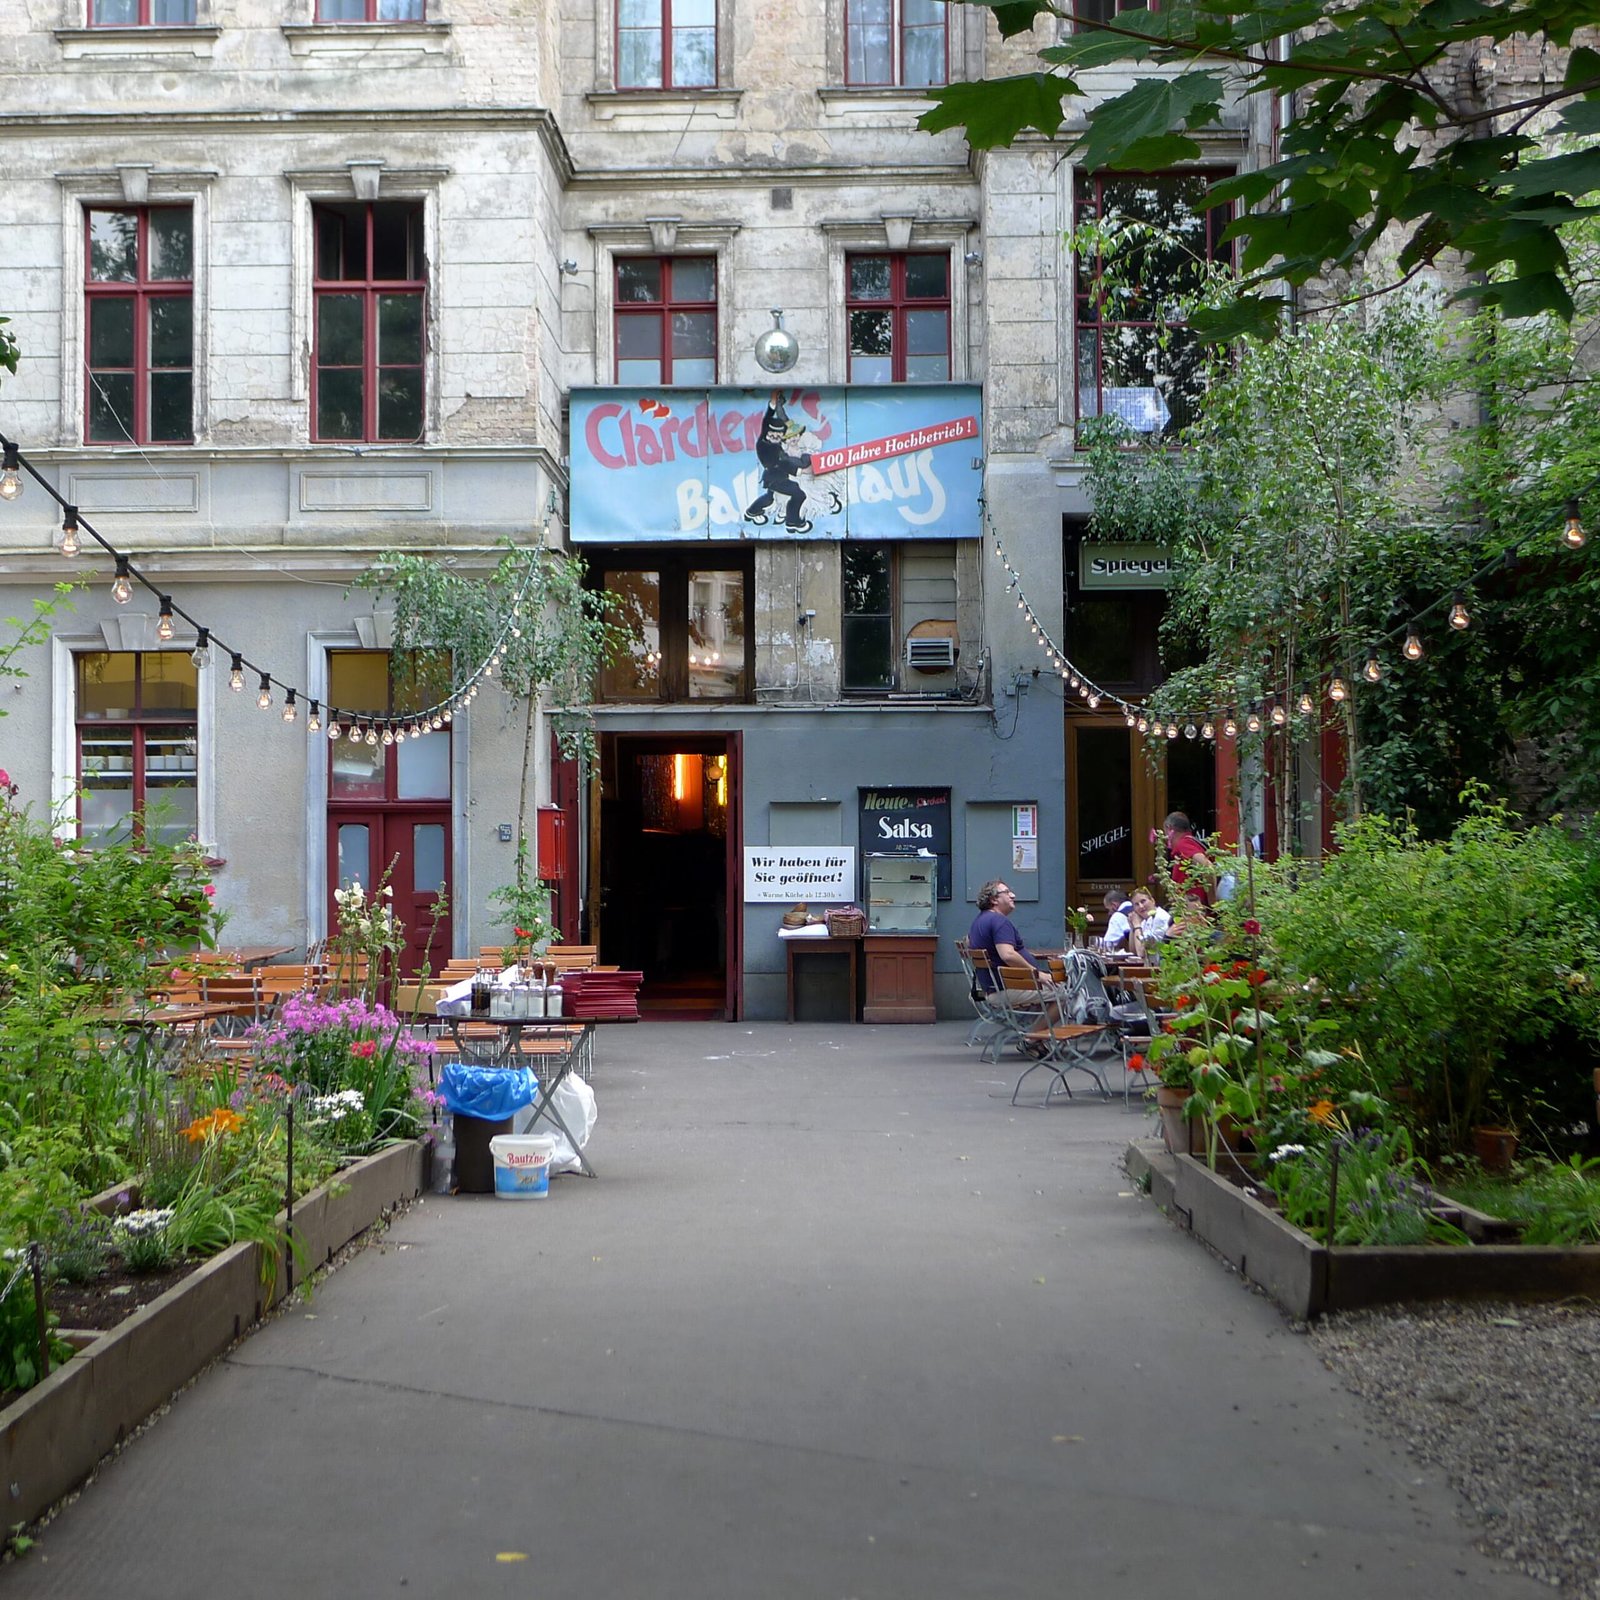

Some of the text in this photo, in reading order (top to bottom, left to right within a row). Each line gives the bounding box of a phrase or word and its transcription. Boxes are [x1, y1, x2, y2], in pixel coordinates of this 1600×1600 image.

[819, 453, 844, 470] 100
[845, 445, 882, 466] Jahre
[884, 423, 964, 454] Hochbetrieb
[864, 793, 908, 810] Heute
[878, 816, 933, 839] Salsa
[1080, 826, 1130, 856] SPIEGEL-
[751, 856, 847, 868] Wir haben für
[754, 872, 843, 885] Sie geöffnet!
